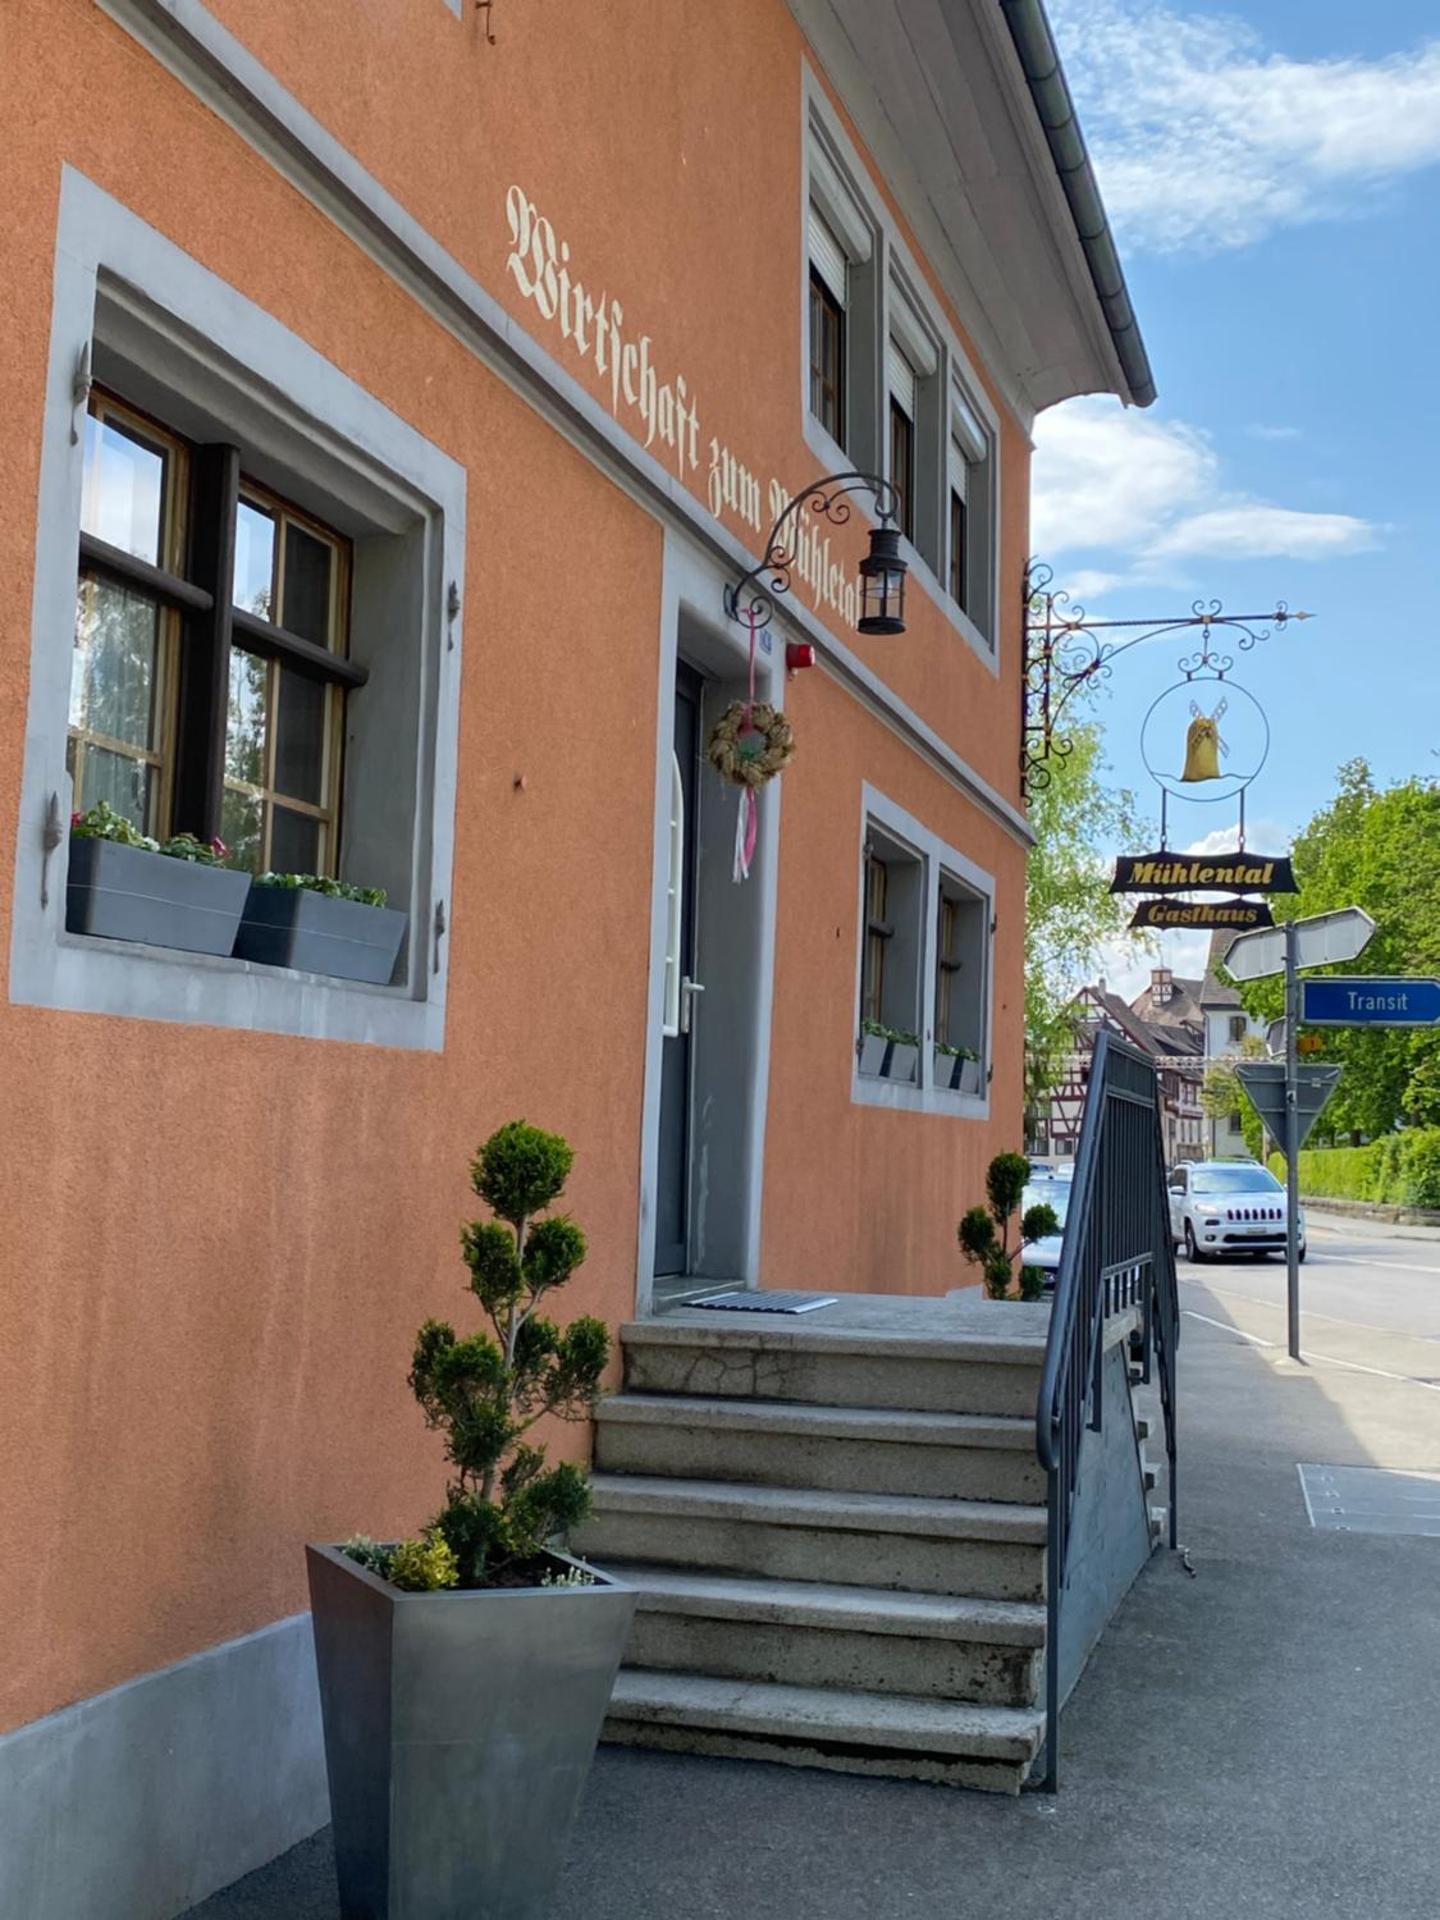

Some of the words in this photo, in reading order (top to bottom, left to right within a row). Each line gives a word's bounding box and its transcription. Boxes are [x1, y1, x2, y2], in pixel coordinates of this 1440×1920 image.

[708, 436, 761, 534] zum
[1128, 862, 1274, 885] Mühlental
[1147, 904, 1258, 923] Gasthaus
[1347, 991, 1408, 1011] Transit
